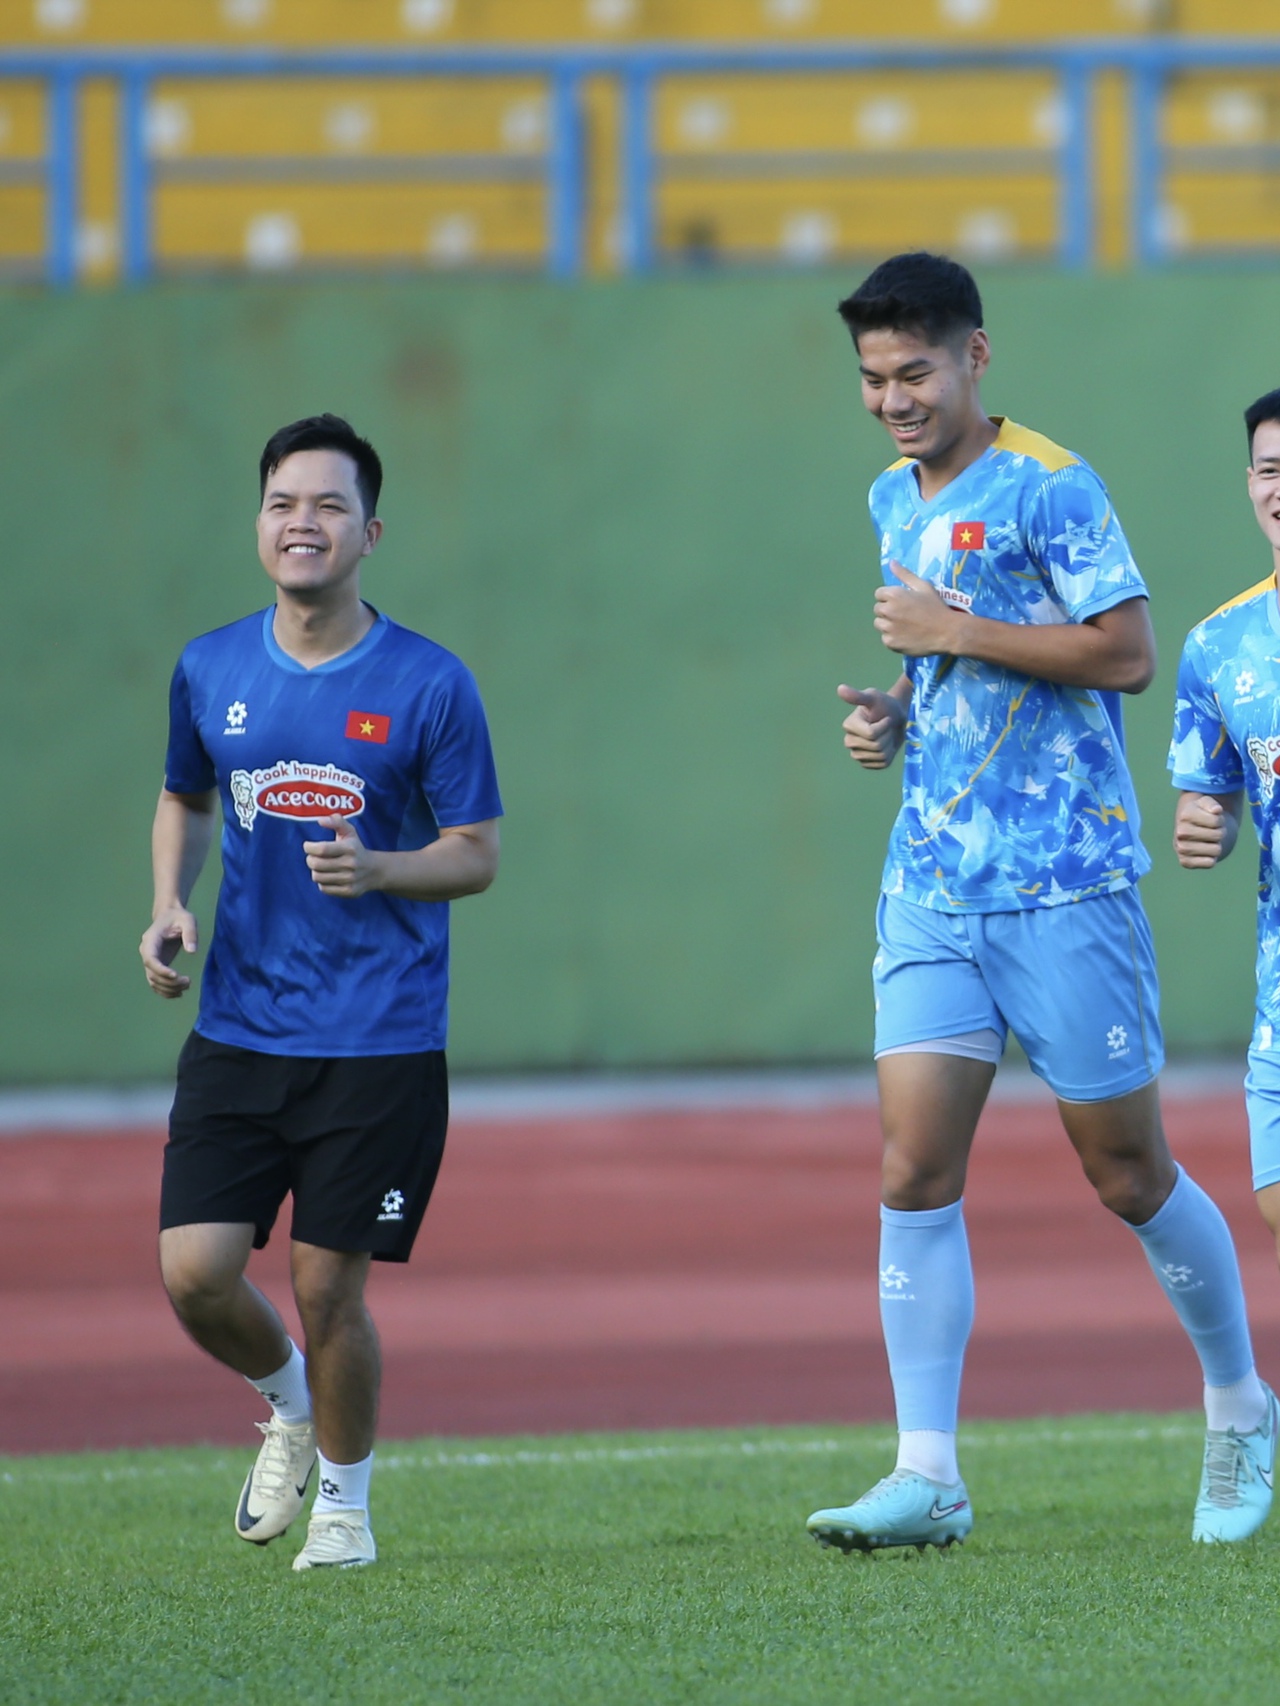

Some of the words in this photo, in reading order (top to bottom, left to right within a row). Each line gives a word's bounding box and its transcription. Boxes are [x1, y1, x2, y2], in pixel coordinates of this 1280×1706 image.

[937, 586, 970, 606] iness
[254, 764, 289, 785] Cook
[293, 763, 363, 789] happiness
